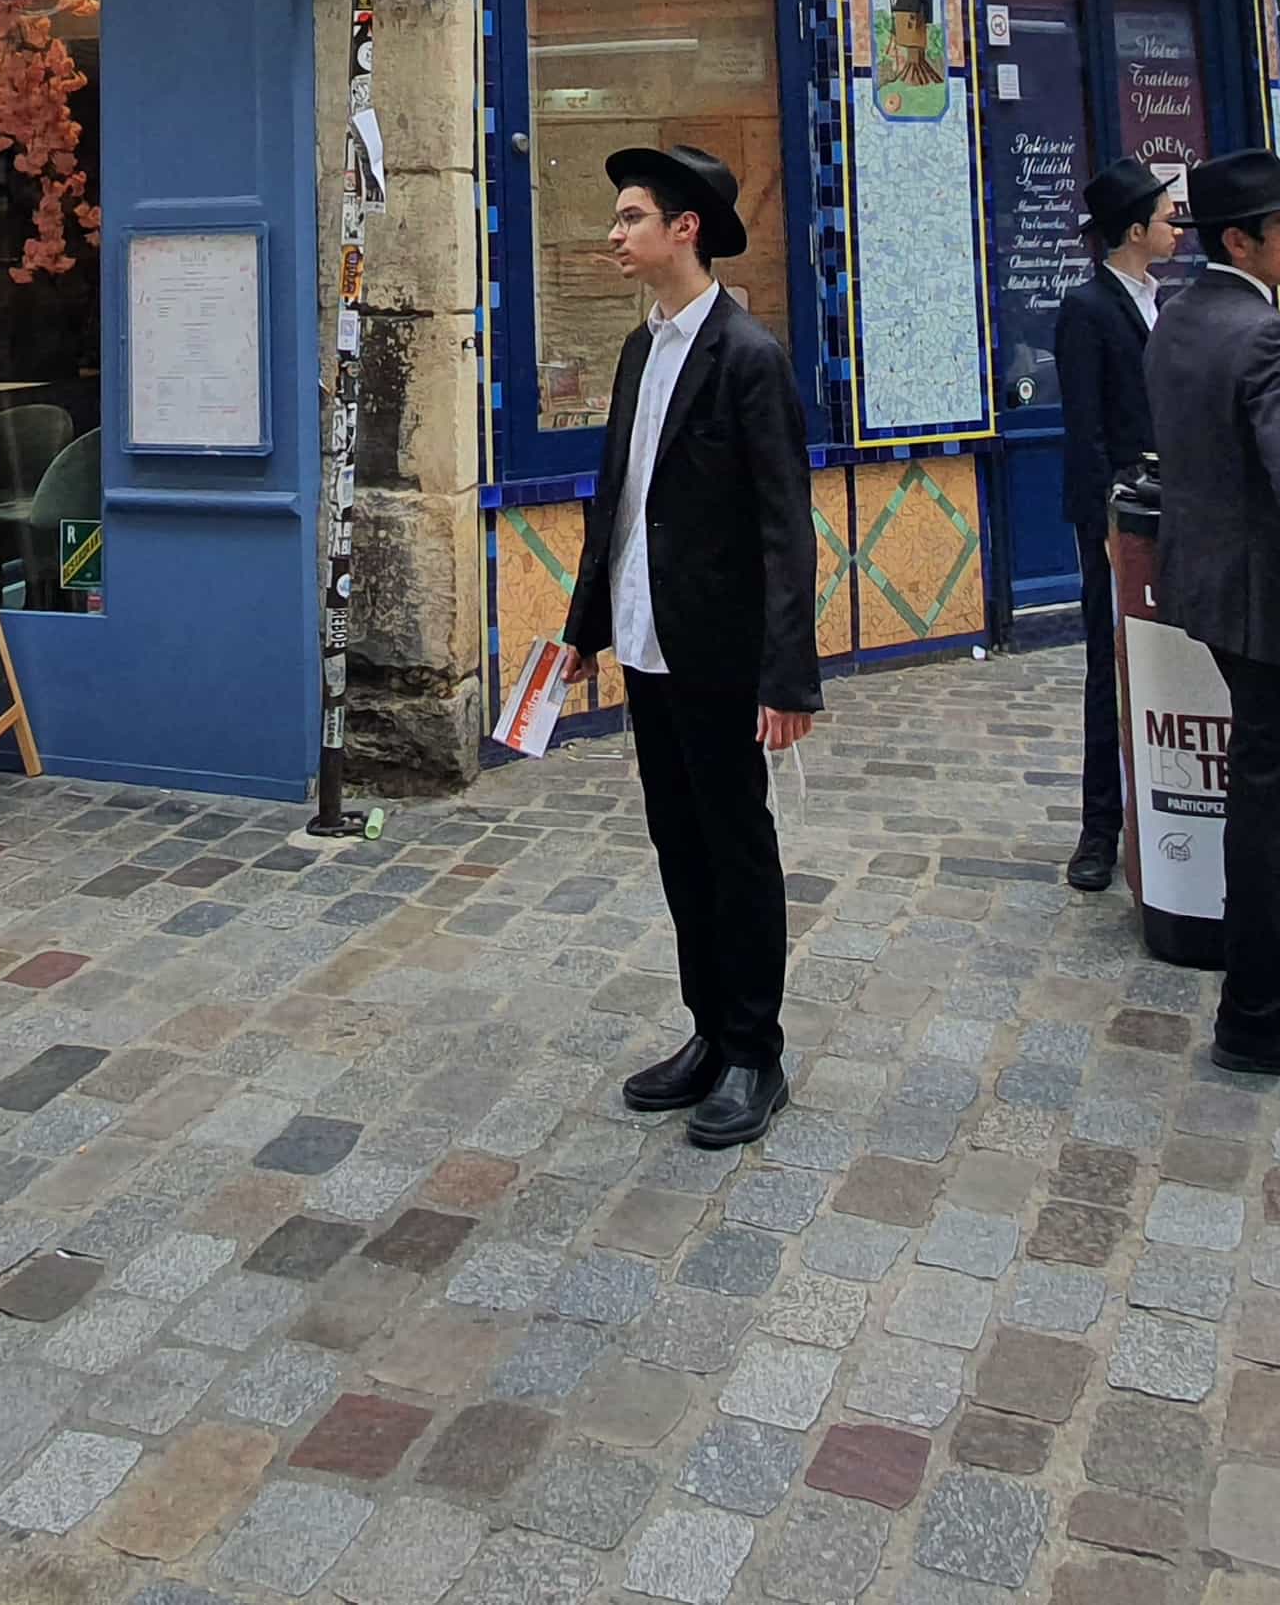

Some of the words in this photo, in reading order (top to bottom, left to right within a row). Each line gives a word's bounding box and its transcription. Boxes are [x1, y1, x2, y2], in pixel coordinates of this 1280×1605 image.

[1136, 35, 1179, 60] Votre
[1131, 92, 1191, 123] Yiddish
[1134, 136, 1205, 170] LORENC
[1016, 156, 1072, 185] Yiddish
[1145, 709, 1233, 754] METT
[1150, 748, 1193, 789] LES
